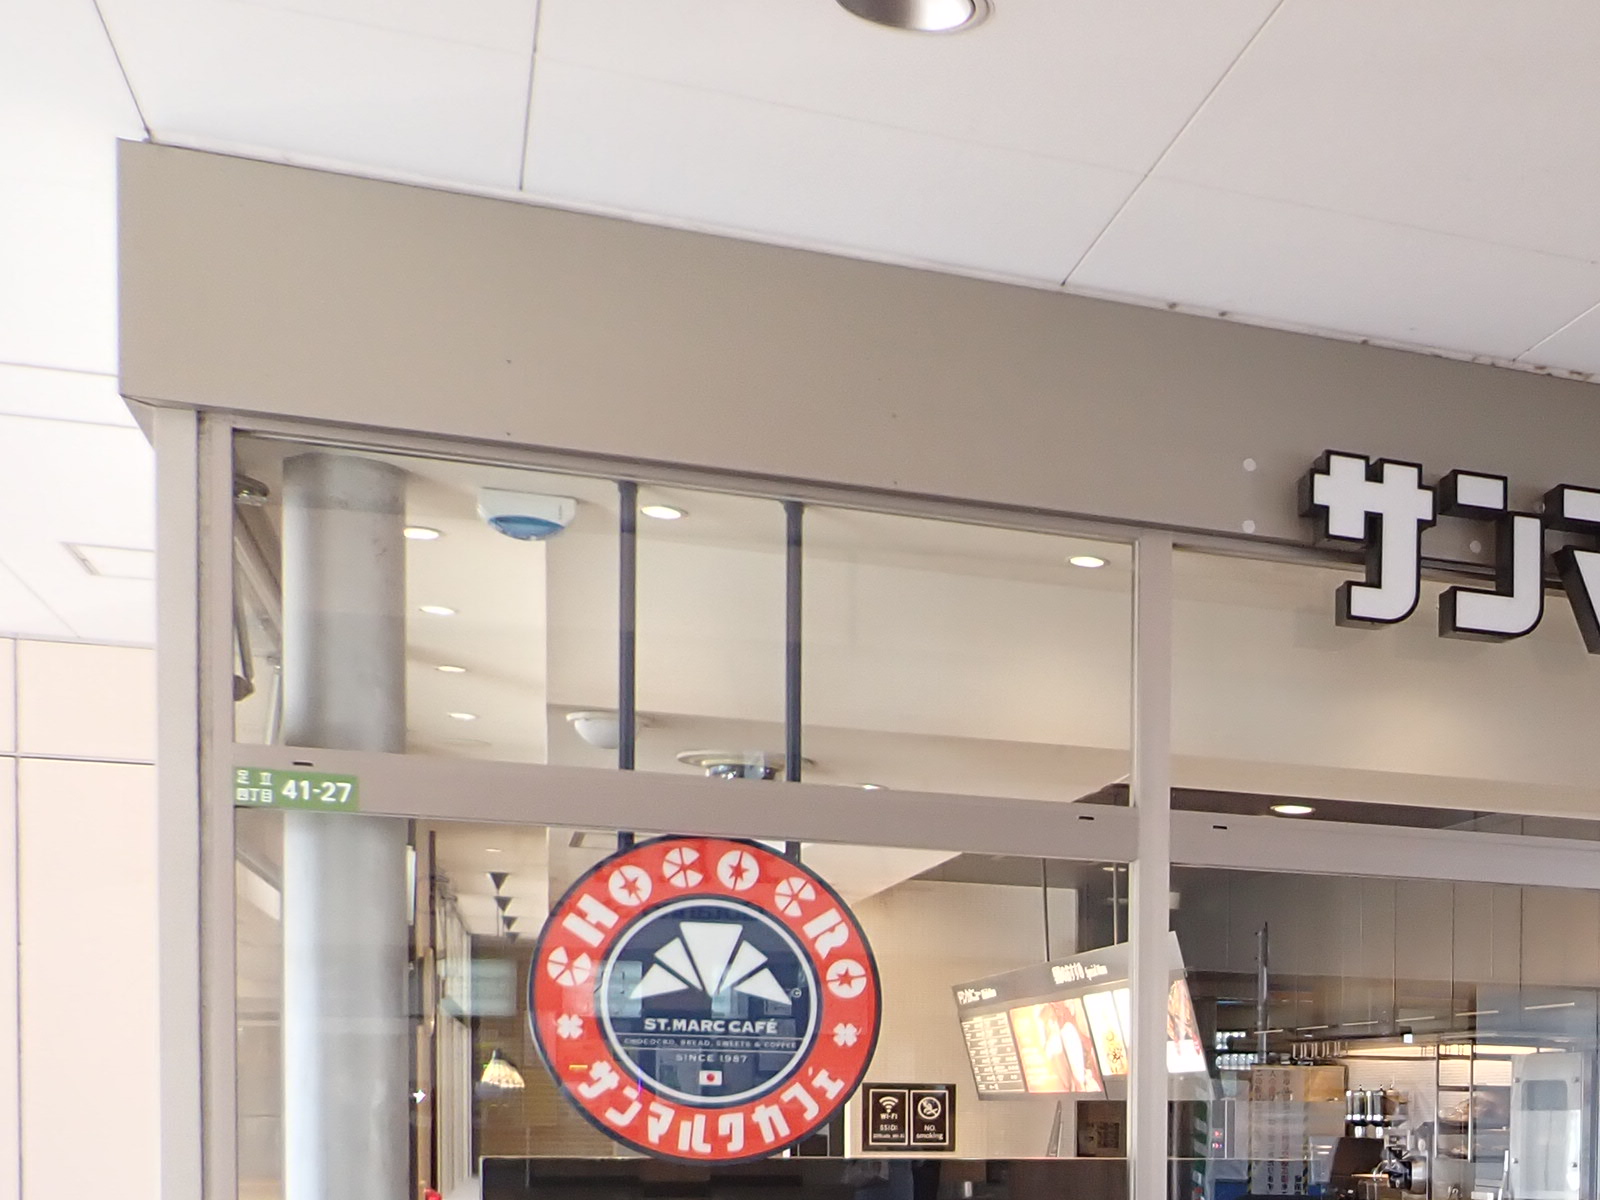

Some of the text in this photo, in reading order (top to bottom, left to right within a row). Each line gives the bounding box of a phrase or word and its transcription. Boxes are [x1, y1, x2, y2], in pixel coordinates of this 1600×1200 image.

[281, 779, 352, 803] 41-27
[728, 1017, 779, 1035] CAFÉ
[676, 1053, 749, 1064] SINCE 1987
[577, 1060, 846, 1154] サンマルクカフェ
